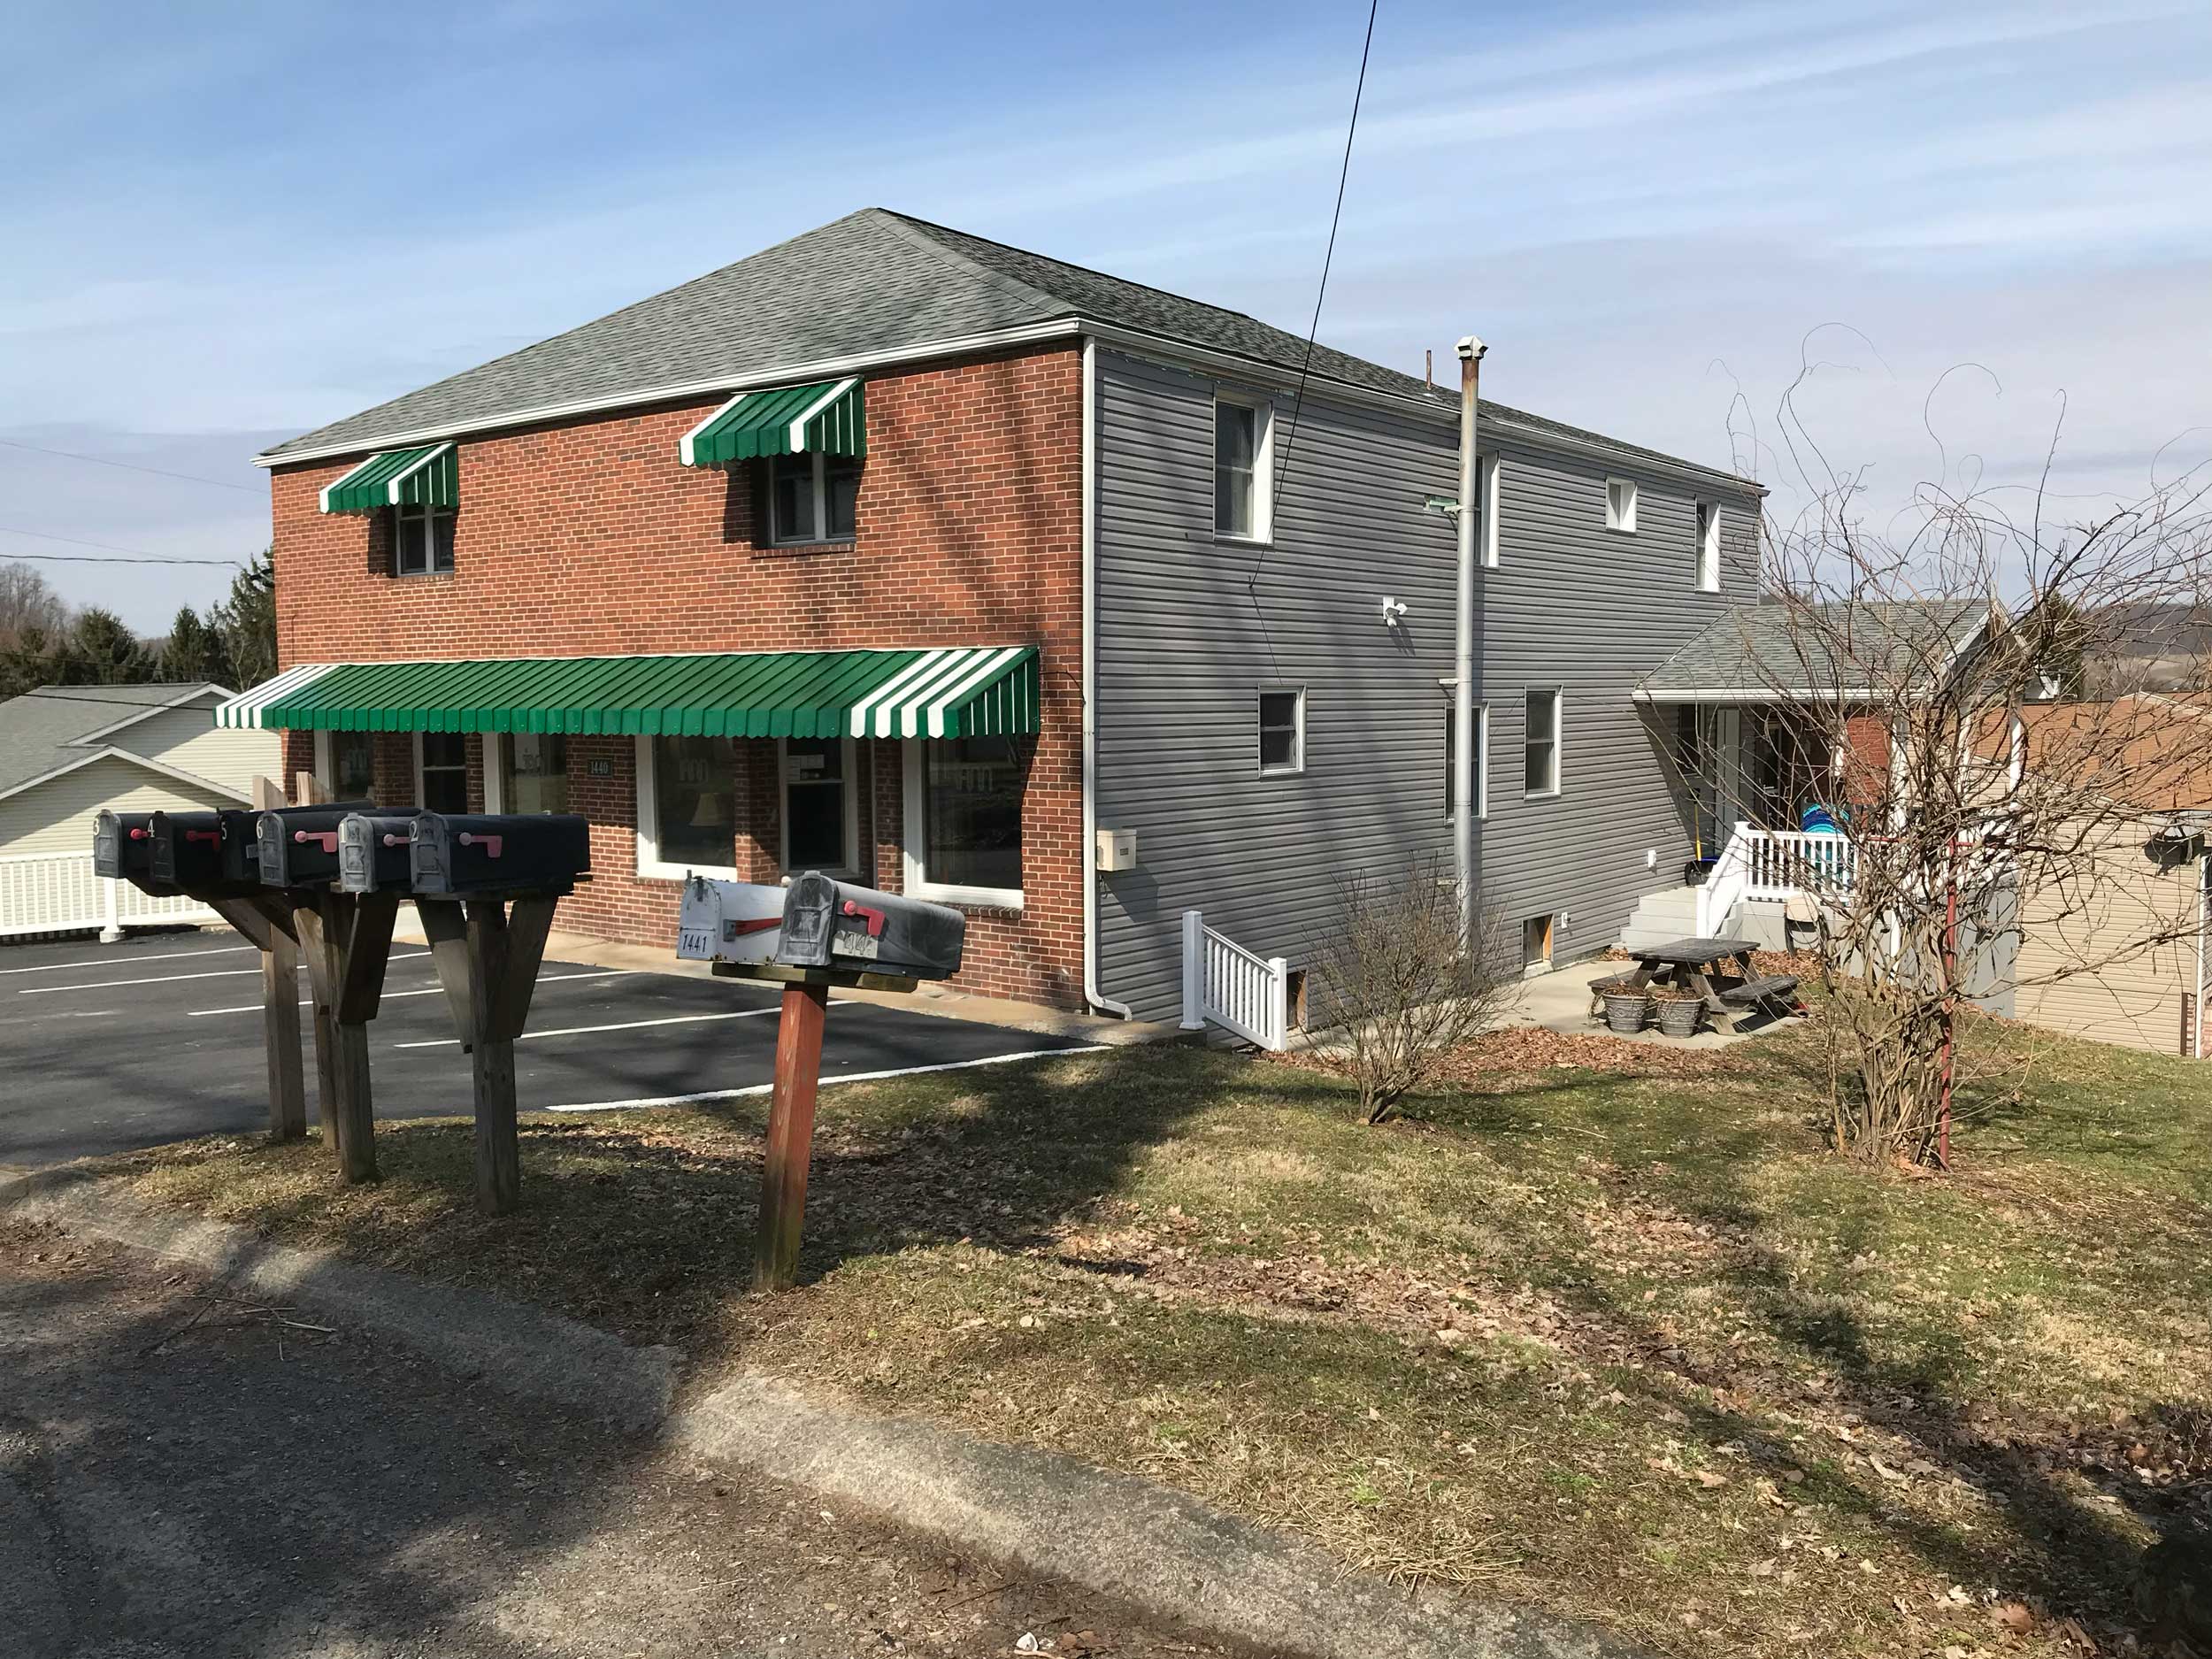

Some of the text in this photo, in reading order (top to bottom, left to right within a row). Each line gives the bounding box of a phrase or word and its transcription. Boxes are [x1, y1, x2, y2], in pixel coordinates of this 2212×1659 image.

[590, 761, 609, 774] 1440
[93, 818, 99, 836] 3
[147, 819, 156, 838] 4
[220, 822, 227, 841] 5
[256, 820, 264, 839] 6
[339, 823, 347, 843] 1
[409, 820, 419, 842] 2
[682, 934, 707, 953] 1441
